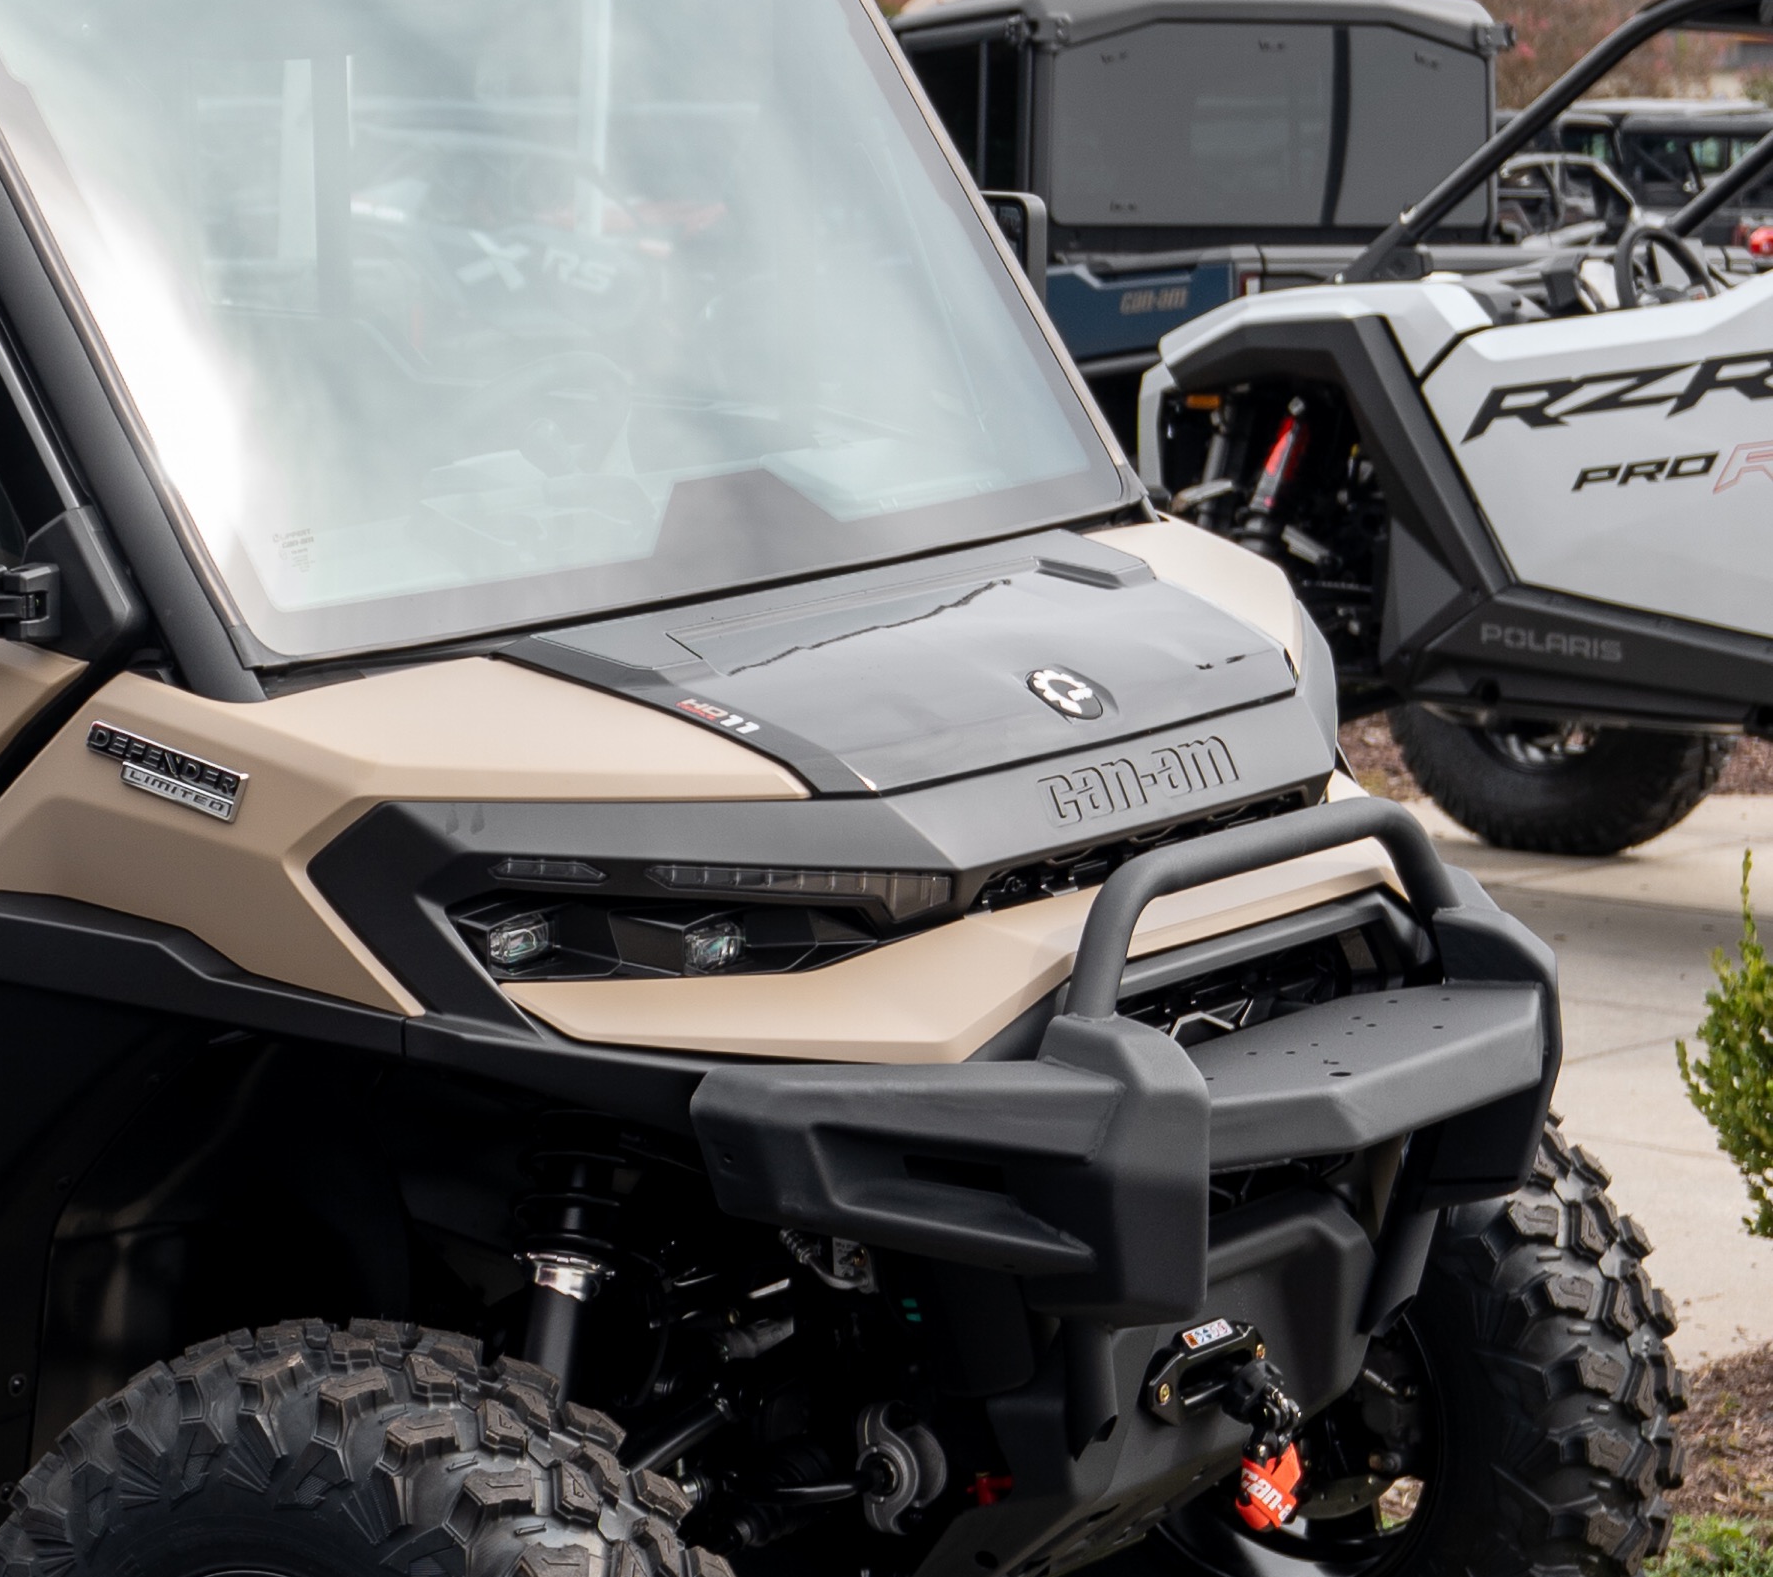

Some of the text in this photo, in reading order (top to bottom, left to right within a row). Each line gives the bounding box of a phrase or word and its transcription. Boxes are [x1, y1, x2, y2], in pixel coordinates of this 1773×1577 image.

[1119, 287, 1189, 316] can-am
[1461, 348, 1773, 445] RZR
[1571, 451, 1719, 493] PRO
[1481, 622, 1622, 662] POLARIS
[89, 728, 238, 797] DEFENDER
[1037, 735, 1240, 828] can-am
[129, 770, 225, 812] LIMITED
